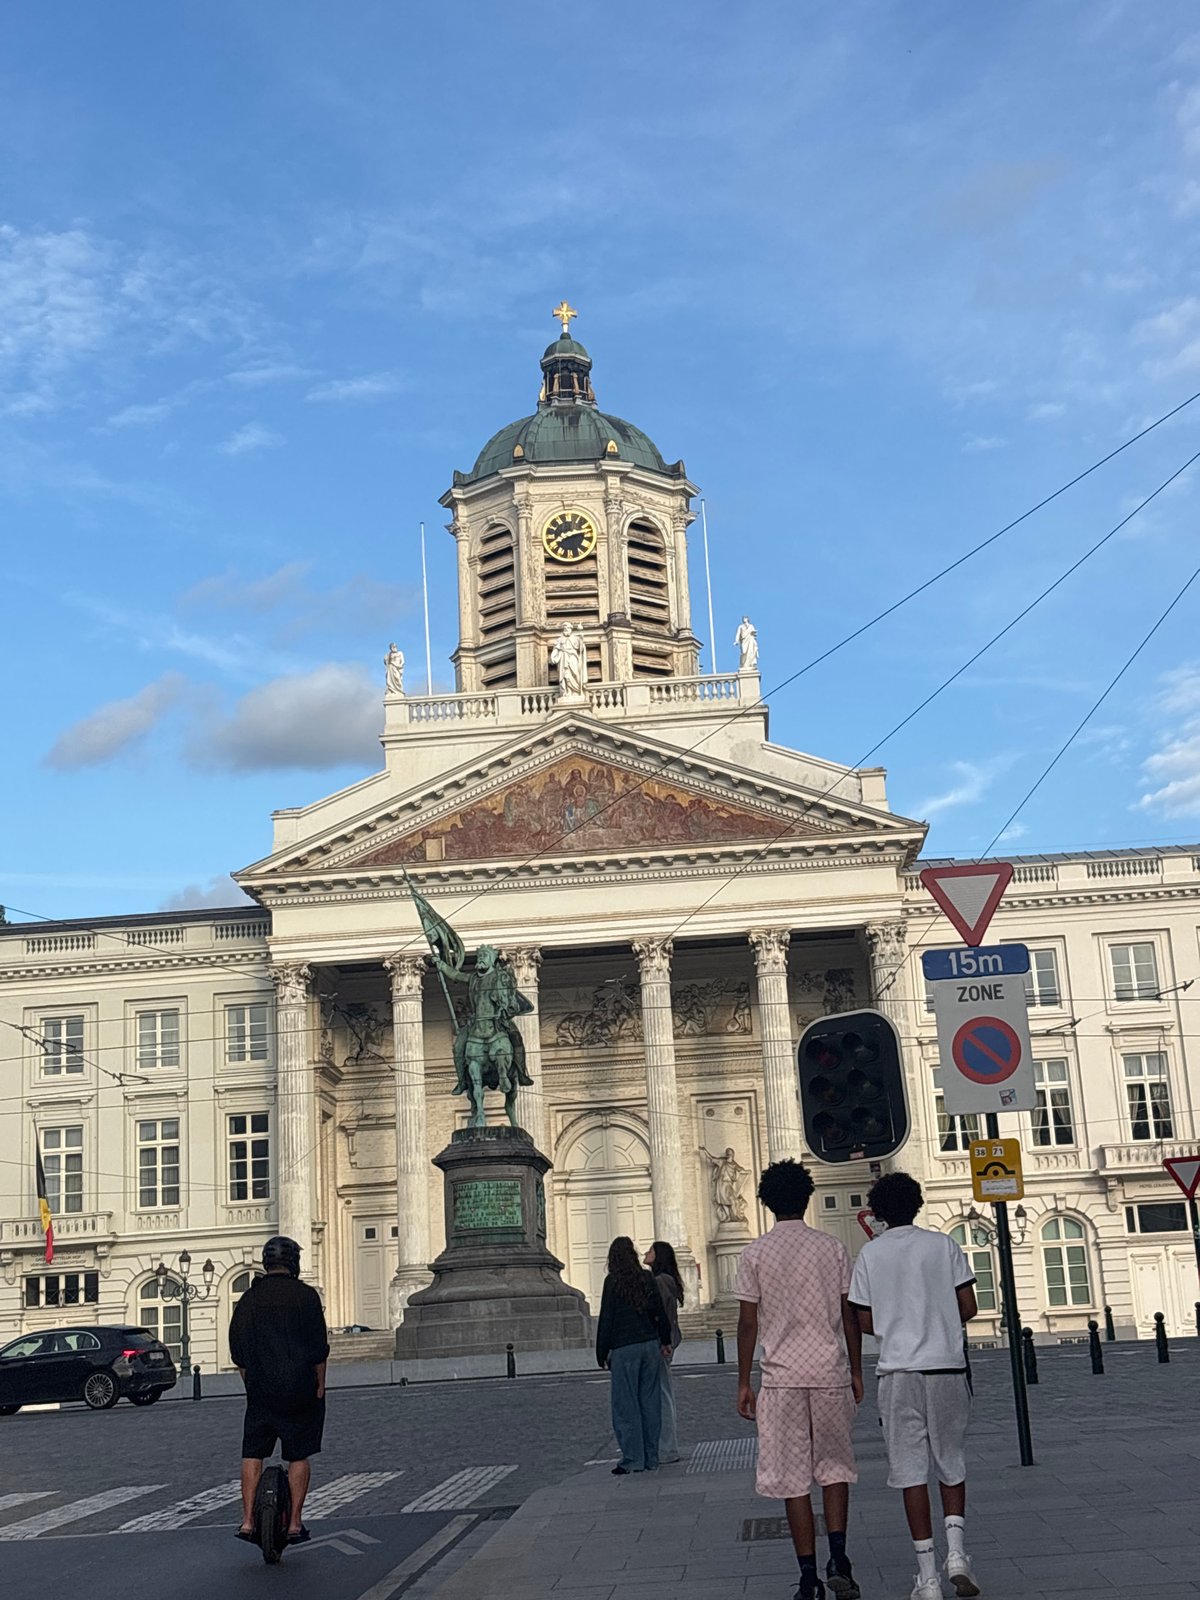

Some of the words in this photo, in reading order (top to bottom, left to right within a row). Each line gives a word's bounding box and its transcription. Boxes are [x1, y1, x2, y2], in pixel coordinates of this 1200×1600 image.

[948, 949, 1003, 976] 15m
[956, 983, 1005, 1003] ZONE
[976, 1148, 986, 1156] 38
[993, 1147, 1003, 1155] 71
